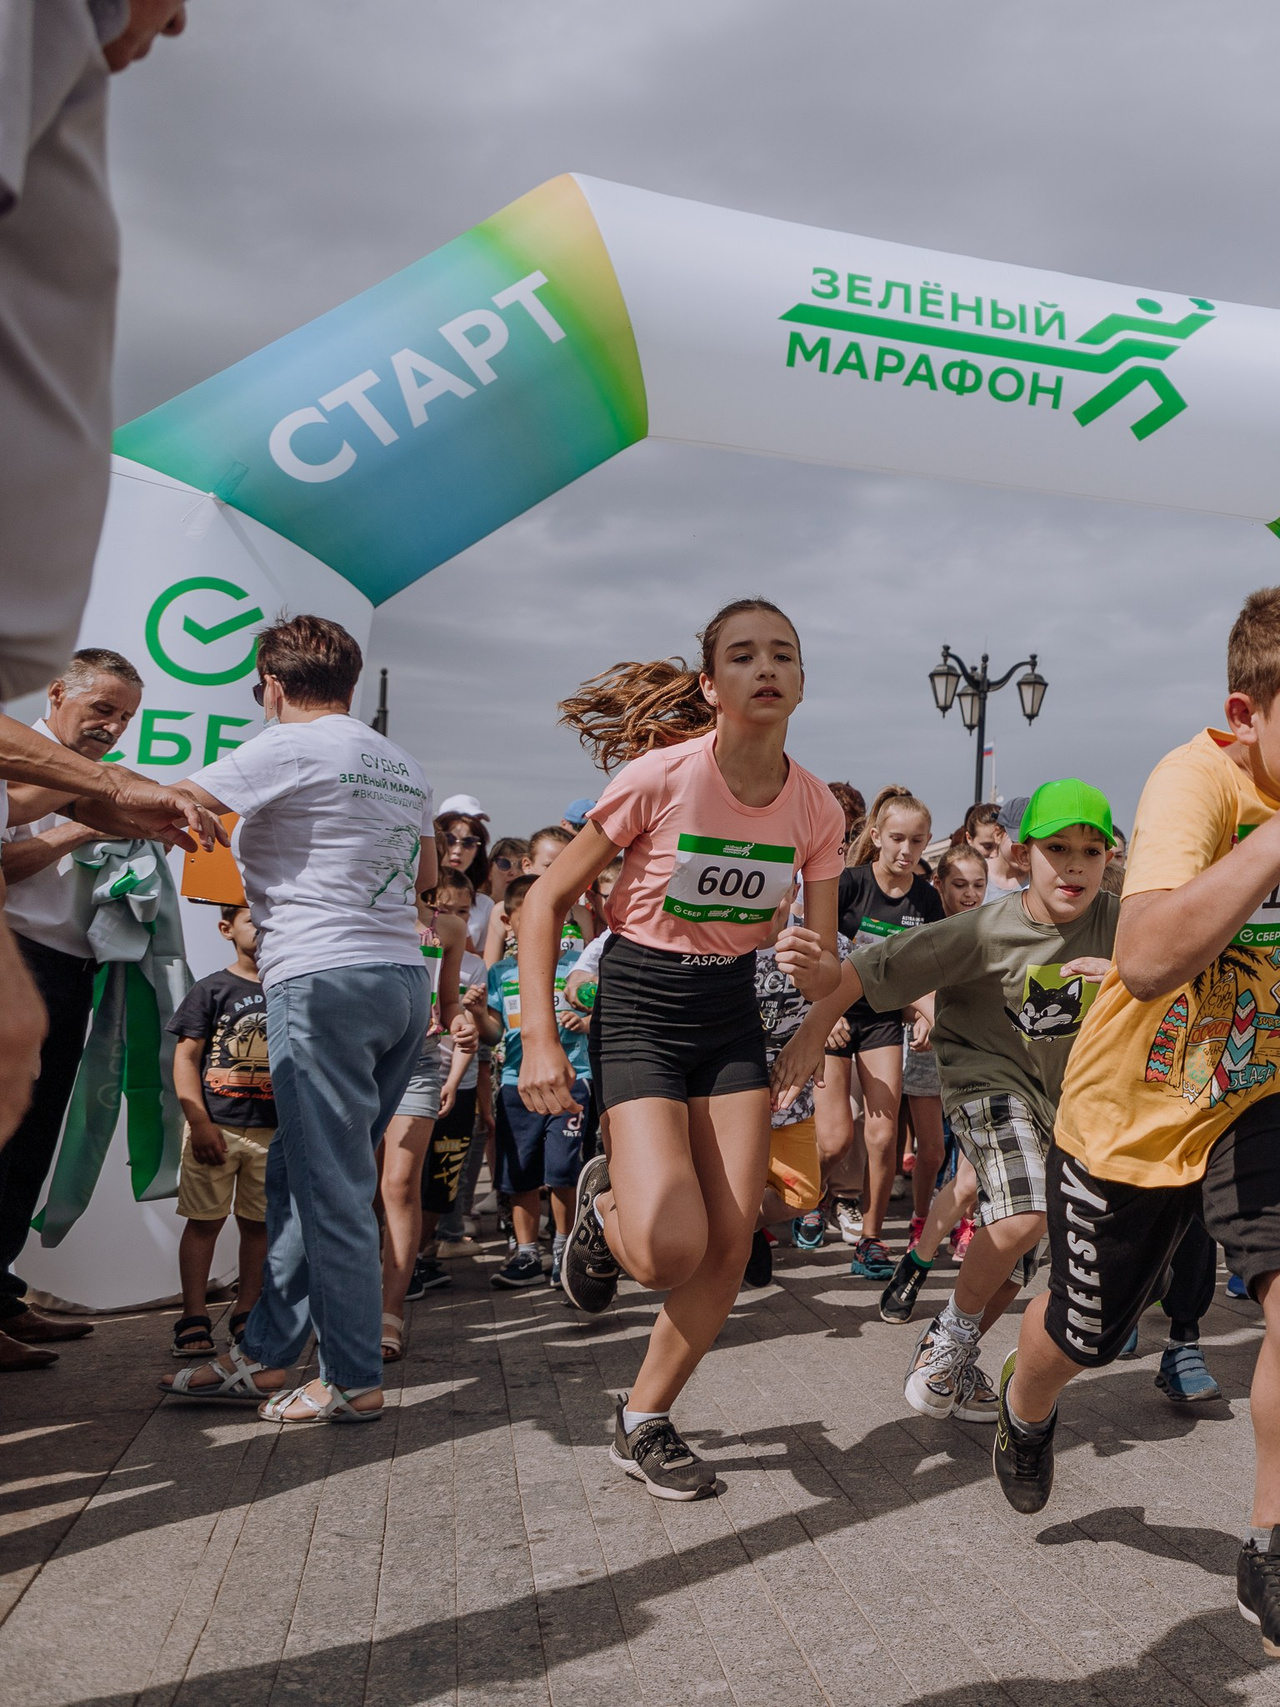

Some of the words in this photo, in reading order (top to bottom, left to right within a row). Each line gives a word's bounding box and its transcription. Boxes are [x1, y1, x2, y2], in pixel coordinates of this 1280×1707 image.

[811, 267, 1067, 340] ЗЕЛЁНЫЙ
[268, 269, 567, 483] СТАРТ
[786, 331, 1064, 410] МАРАФОН
[102, 709, 254, 768] БЕ
[361, 753, 410, 777] СУДЬЯ
[340, 773, 389, 791] ЗЕЛЁНЫЙ
[391, 781, 427, 800] МАРАФ
[697, 866, 765, 899] 600
[1256, 931, 1280, 942] СБЕР
[234, 995, 264, 1012] AND
[1208, 984, 1234, 1009] Enjoy
